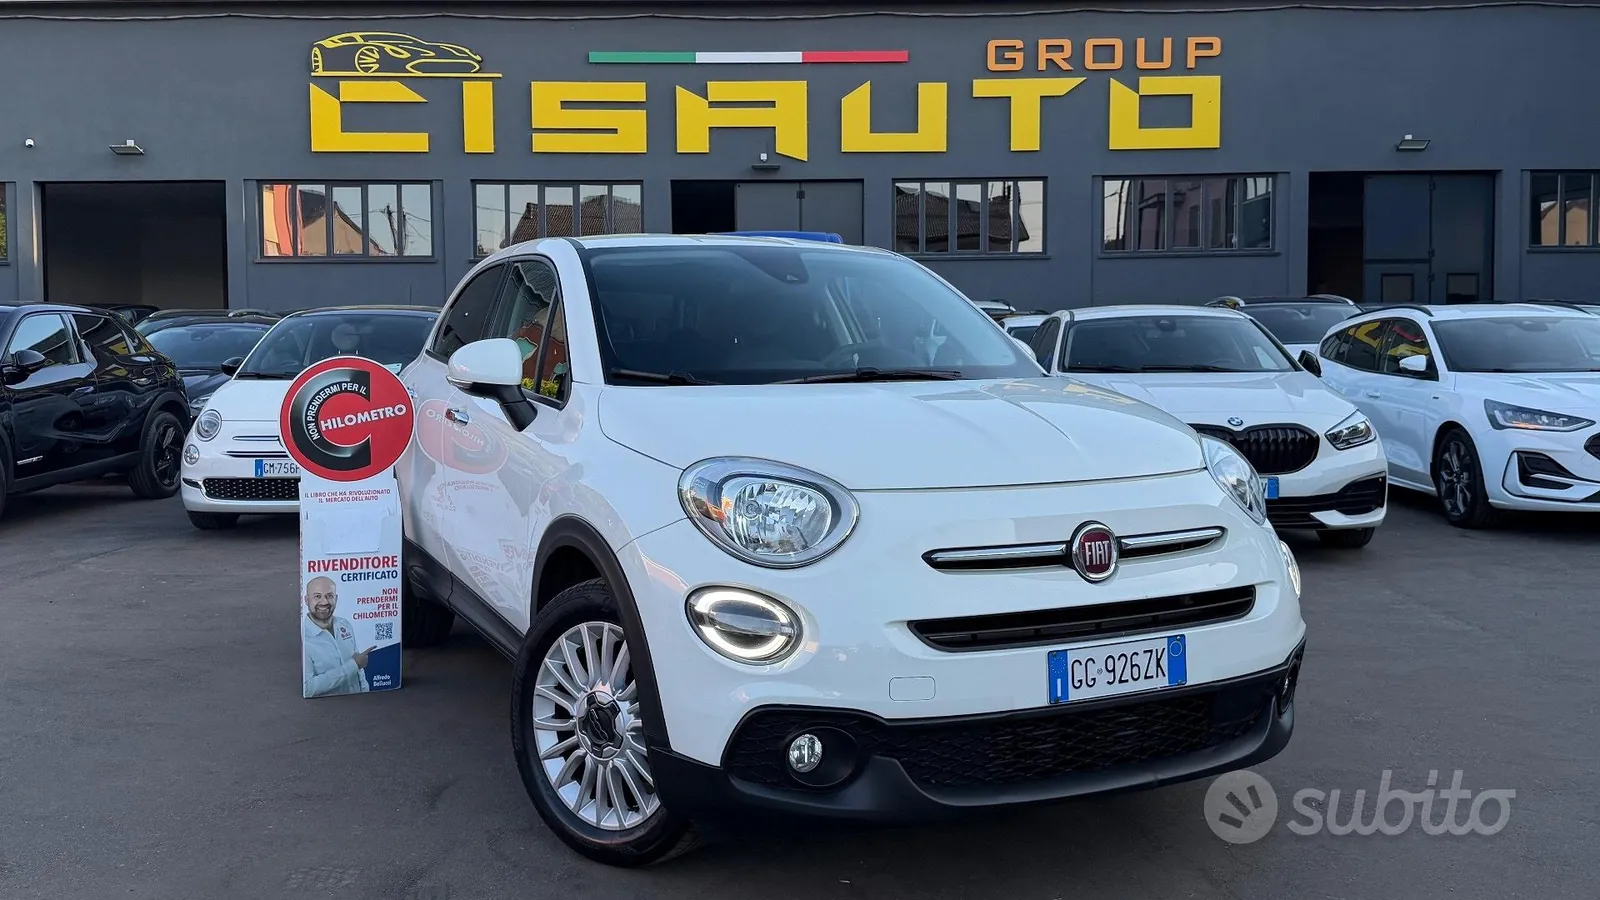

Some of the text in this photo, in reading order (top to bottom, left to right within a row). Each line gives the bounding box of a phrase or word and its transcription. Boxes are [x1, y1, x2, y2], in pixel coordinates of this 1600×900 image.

[986, 36, 1222, 71] GROUP
[309, 75, 1221, 161] CISAUTO
[307, 382, 368, 441] NON PRENDERMI PER IL
[348, 488, 391, 496] RIVOLUZIONATO
[1084, 540, 1110, 566] FIAT
[307, 555, 398, 573] RIVENDITORE
[340, 570, 398, 582] CERTIFICATO
[382, 587, 398, 595] NON
[356, 595, 398, 604] PRENDERMI
[377, 602, 399, 611] PER IL
[352, 609, 398, 620] CHILOMETRO
